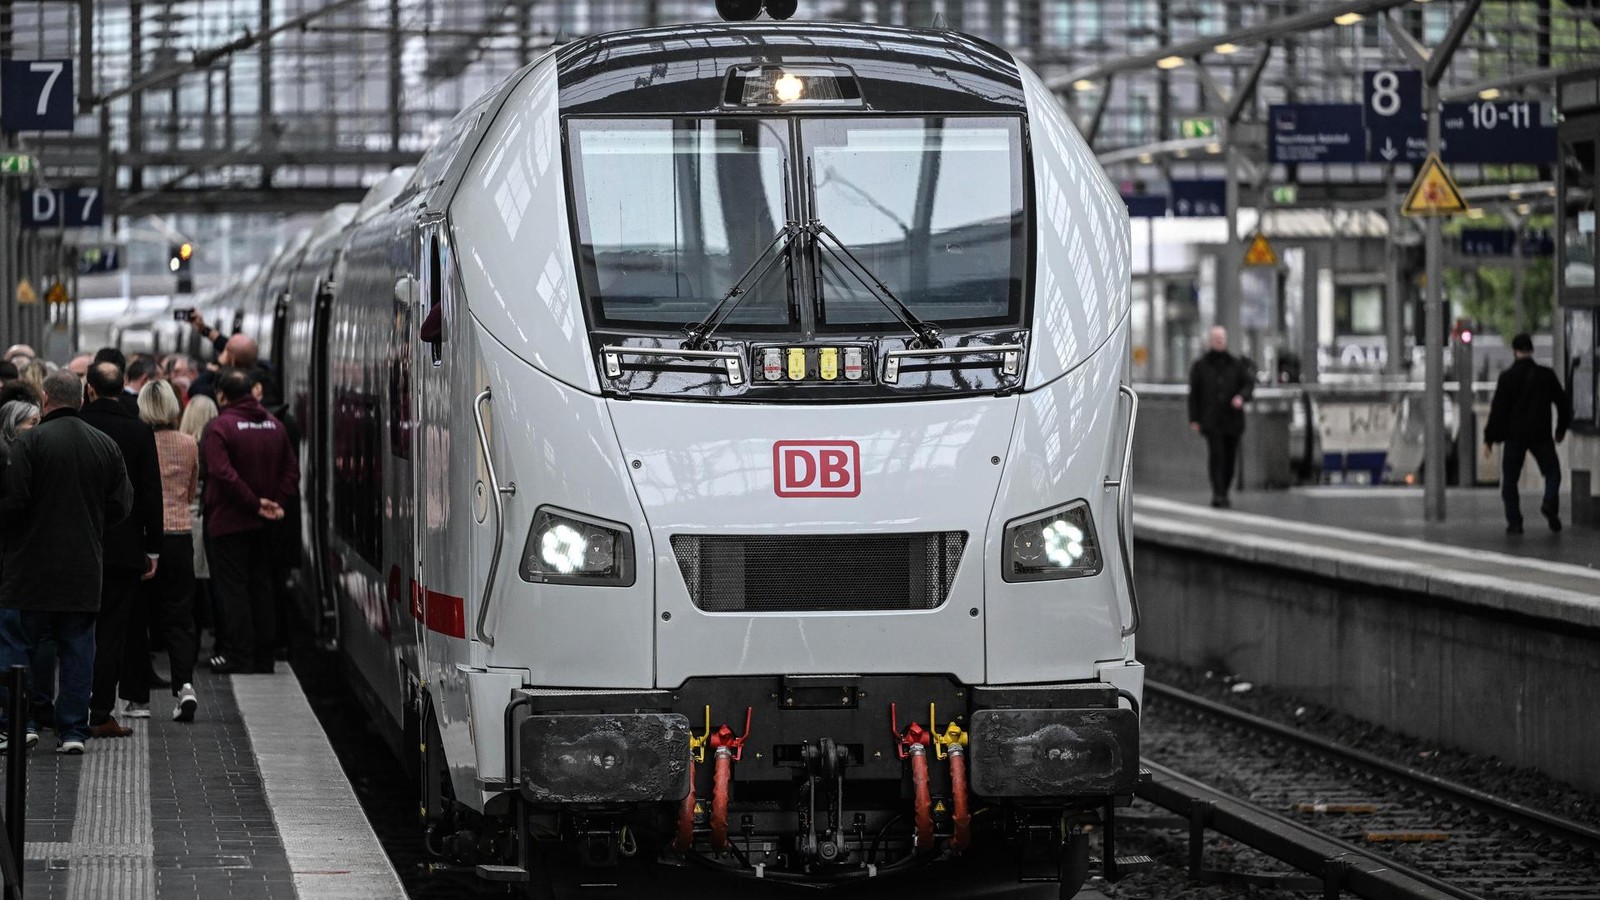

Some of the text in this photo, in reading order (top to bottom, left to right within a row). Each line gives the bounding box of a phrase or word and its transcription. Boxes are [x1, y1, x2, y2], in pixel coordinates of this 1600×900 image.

[29, 62, 64, 116] 7
[1371, 70, 1402, 117] 8
[1468, 101, 1530, 129] 10-11
[32, 187, 99, 222] D 7
[783, 448, 852, 490] DB
